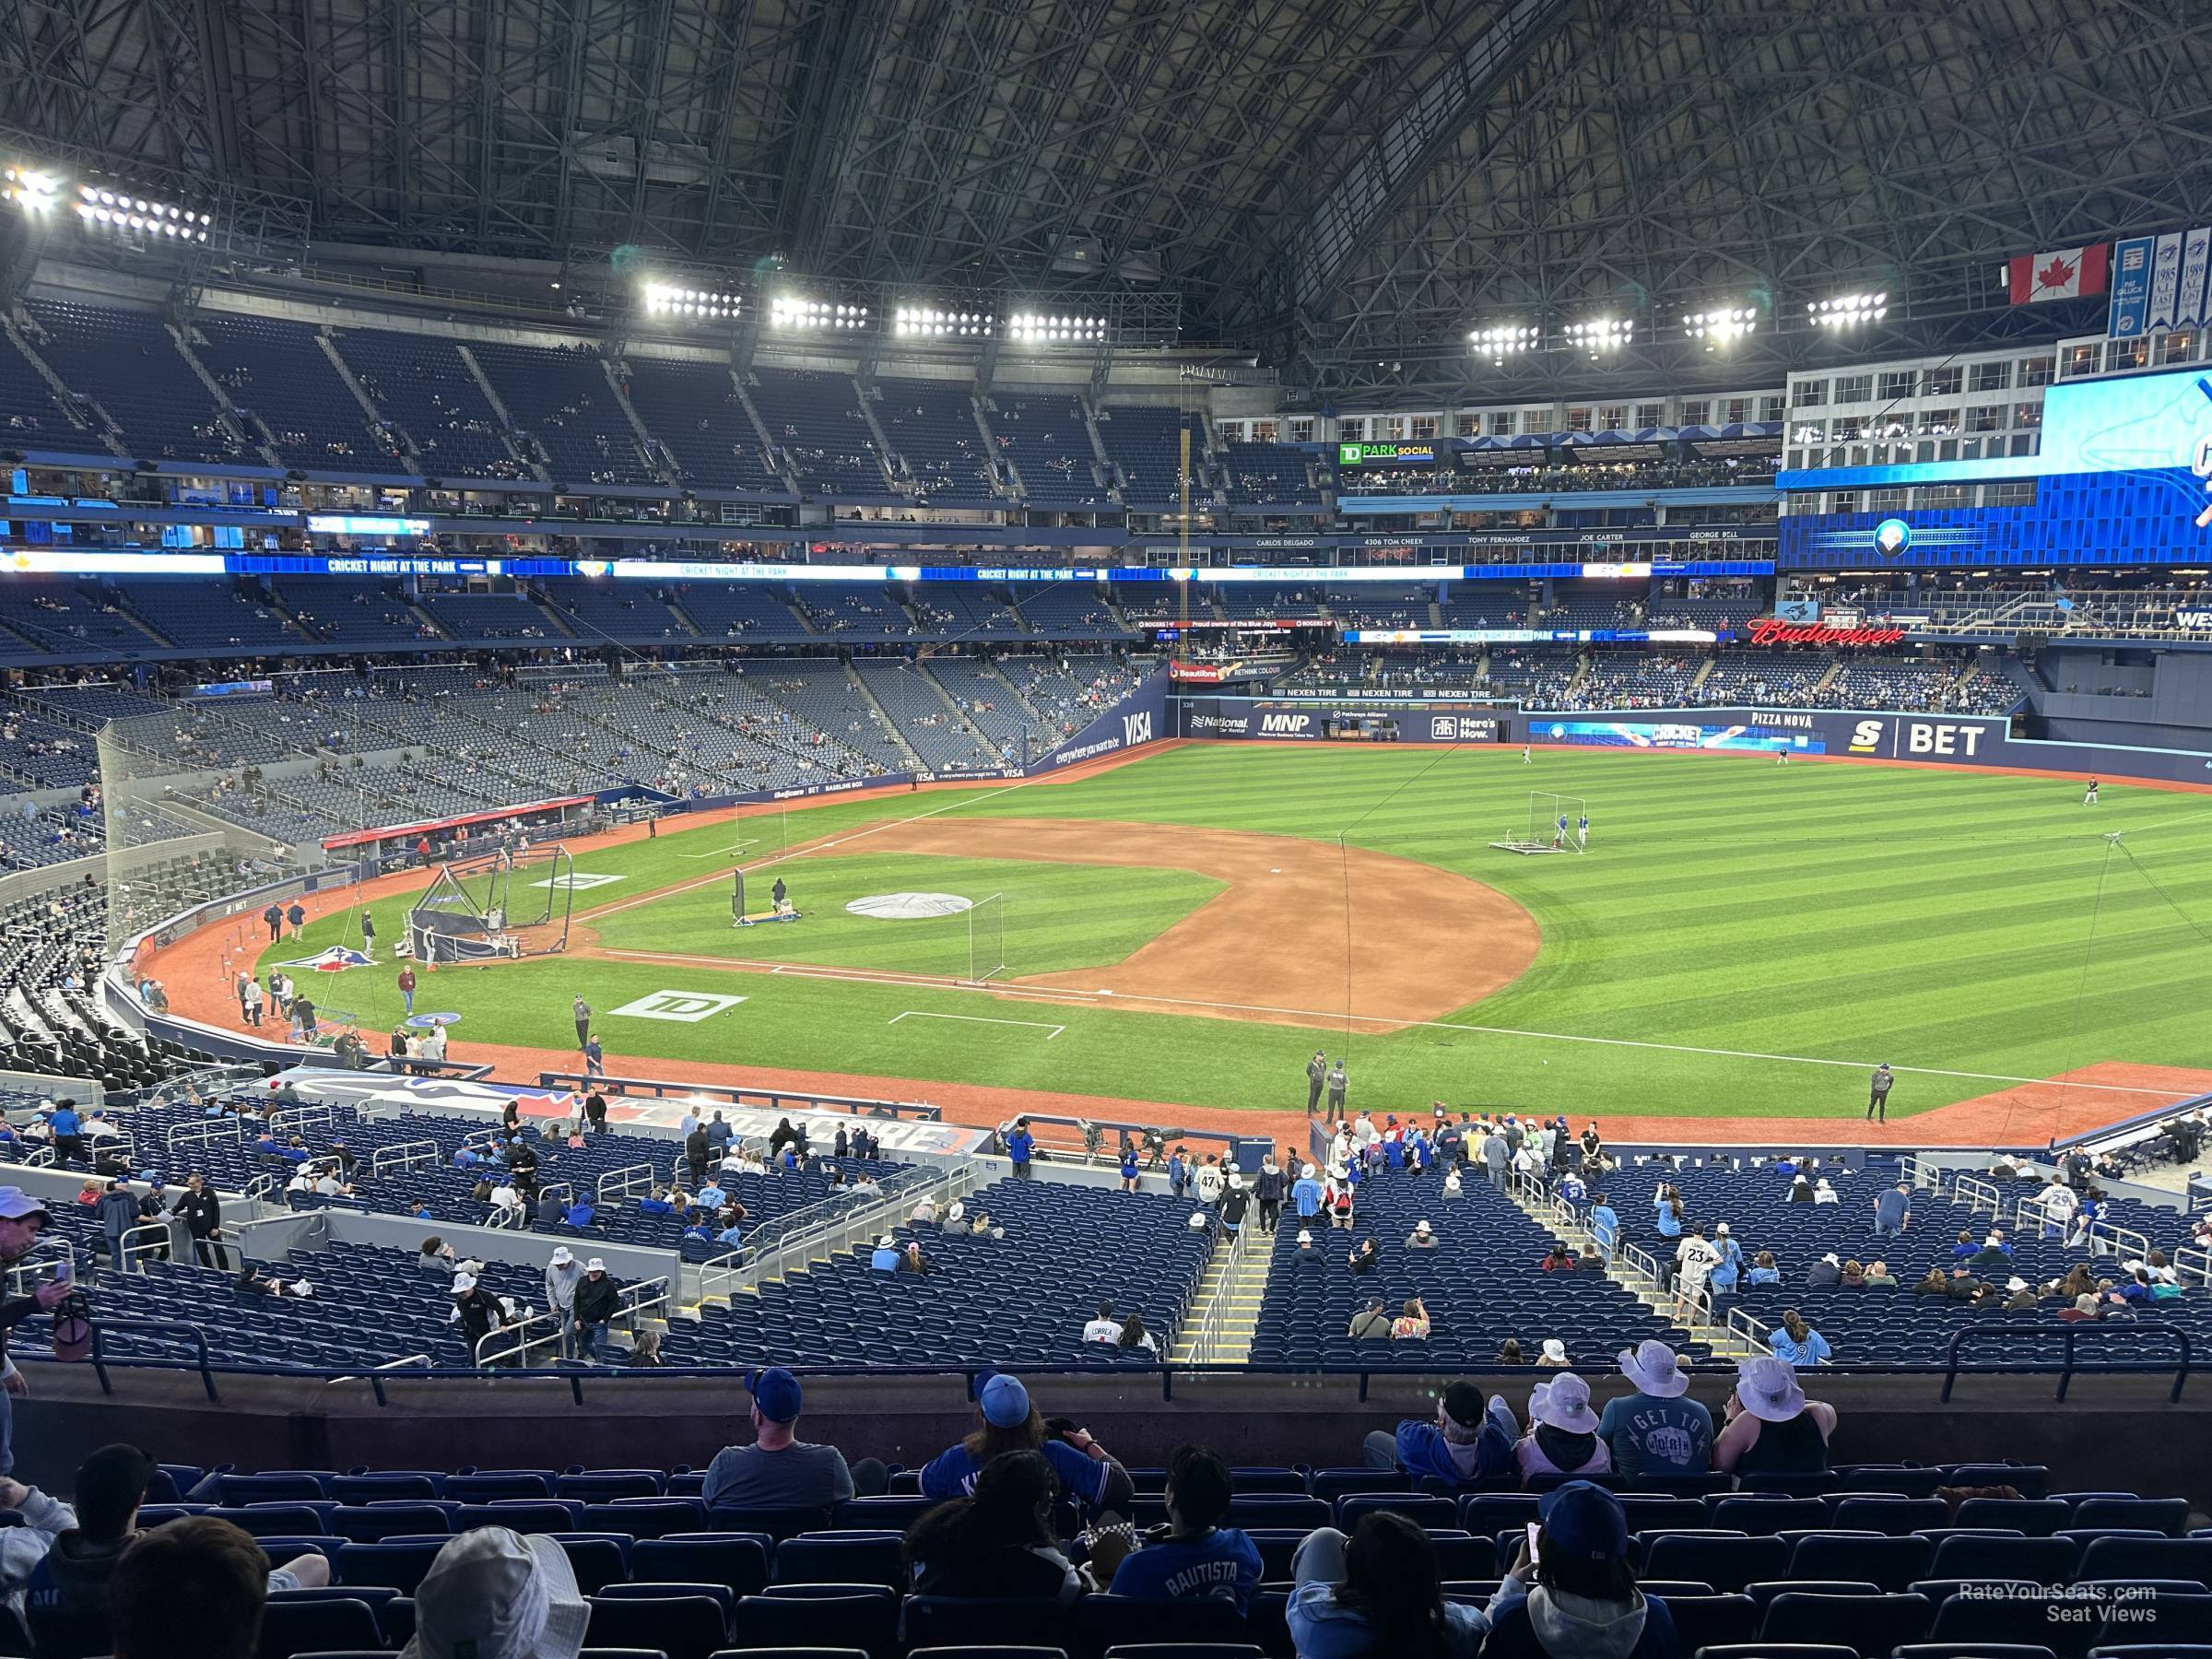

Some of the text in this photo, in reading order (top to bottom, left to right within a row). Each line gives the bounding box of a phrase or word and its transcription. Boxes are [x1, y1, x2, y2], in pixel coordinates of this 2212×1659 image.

[2157, 267, 2176, 282] 1985
[2185, 263, 2205, 277] 1989
[2154, 293, 2172, 305] EAST
[1341, 444, 1434, 461] TD PARK SOCIAL
[1489, 535, 1531, 544] FERNANDEZ
[1689, 531, 1720, 539] GEORGE
[327, 559, 369, 572] CRICKET
[370, 560, 398, 572] NIGHT
[399, 560, 410, 572] AT
[412, 561, 430, 572] THE
[431, 561, 456, 573] PARK
[680, 566, 788, 576] CRICKET NIGHT AT THE PARK
[977, 569, 1074, 580] CRICKET NIGHT AT THE PARK
[1533, 630, 1553, 641] PARK
[1747, 618, 1905, 644] Budweiser
[1234, 666, 1280, 677] RETHINK COLOUR
[1262, 713, 1310, 732] MNP
[1460, 717, 1496, 728] Here's
[1752, 712, 1812, 728] PIZZA NOVA
[1122, 711, 1152, 746] VISA
[1460, 728, 1488, 738] How.
[1652, 724, 1701, 741] CRICKET
[1909, 723, 1985, 756] BET
[1056, 737, 1120, 764] everywhere you want to be
[1002, 768, 1025, 778] VISA
[807, 785, 820, 794] BET
[825, 782, 852, 792] BASELINE
[645, 994, 722, 1015] TD
[1201, 1176, 1216, 1188] 47
[2052, 1194, 2070, 1205] 29
[1688, 1248, 1704, 1263] 23
[1092, 1327, 1112, 1336] CORREA
[1796, 1345, 1807, 1359] 9
[1633, 1409, 1701, 1432] GET TO
[1648, 1438, 1689, 1451] WORK
[1165, 1561, 1238, 1597] BAUTISTA
